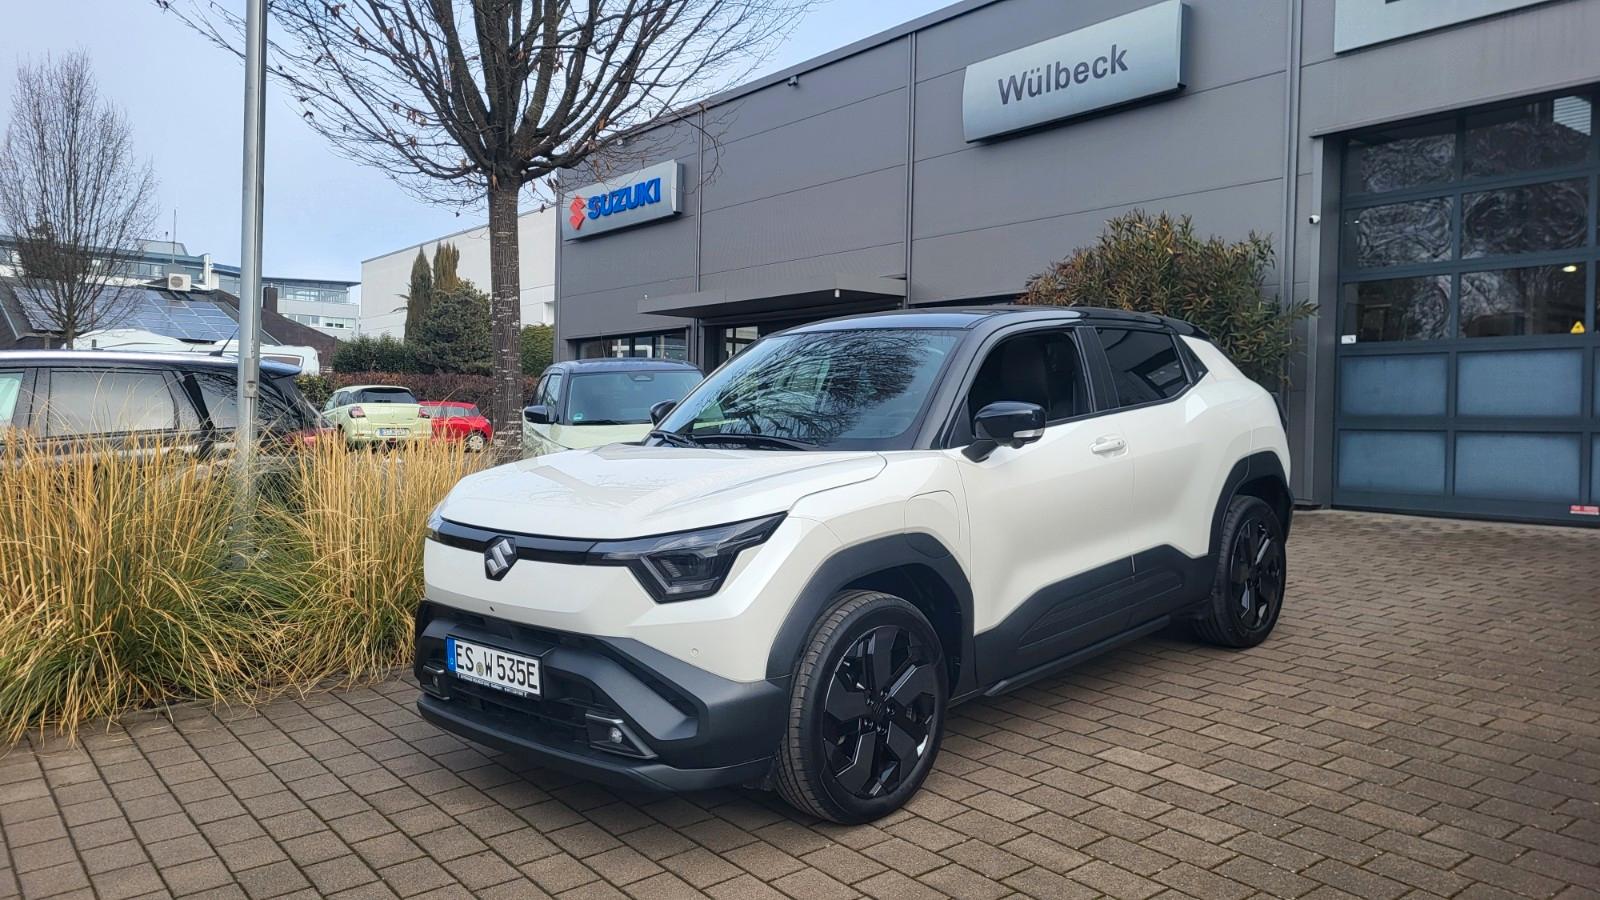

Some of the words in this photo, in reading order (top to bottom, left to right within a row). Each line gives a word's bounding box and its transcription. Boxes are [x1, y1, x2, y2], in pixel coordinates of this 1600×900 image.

[998, 44, 1128, 105] Wülbeck
[588, 178, 661, 219] SUZUKI
[456, 644, 474, 672] ES
[484, 651, 493, 678] W
[497, 654, 537, 689] 535E
